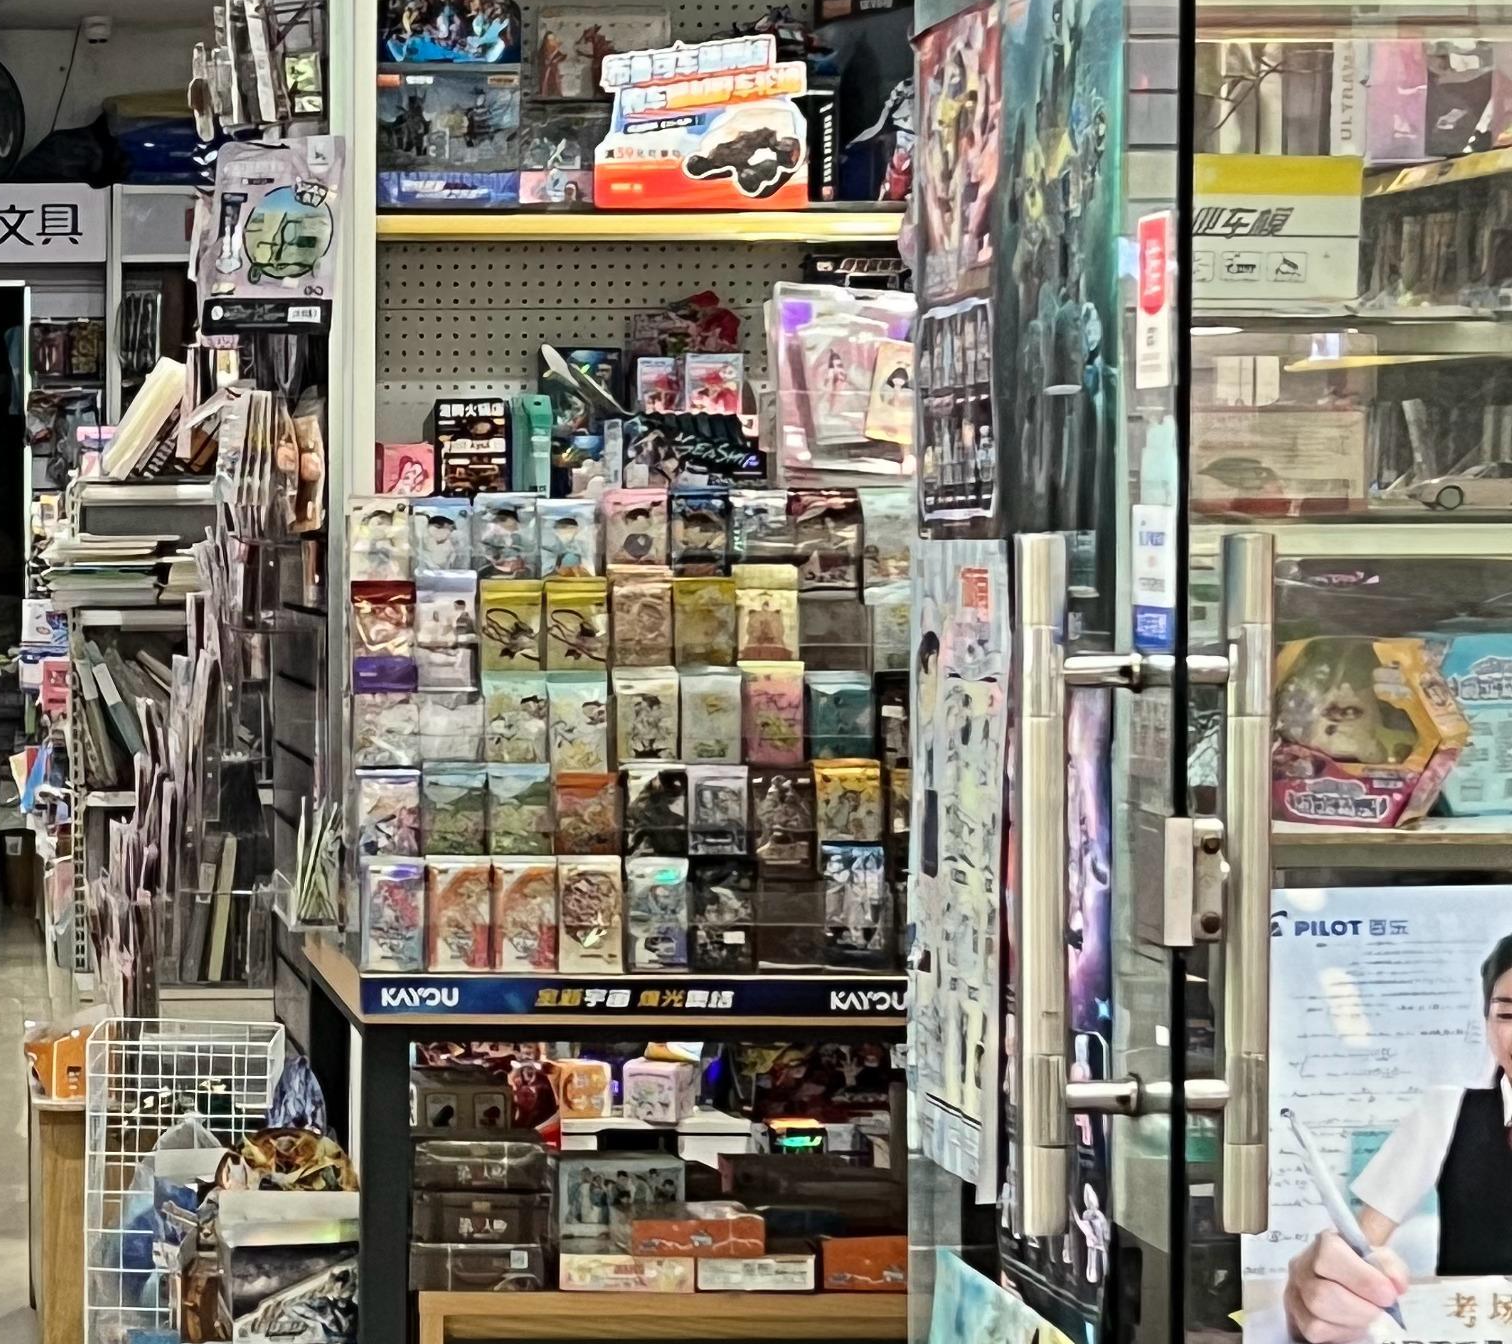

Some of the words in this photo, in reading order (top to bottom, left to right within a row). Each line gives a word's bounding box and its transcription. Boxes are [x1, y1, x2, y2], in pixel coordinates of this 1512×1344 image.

[1294, 920, 1363, 937] PILOT
[381, 987, 459, 1007] KAYOU
[830, 990, 908, 1011] KAYOU
